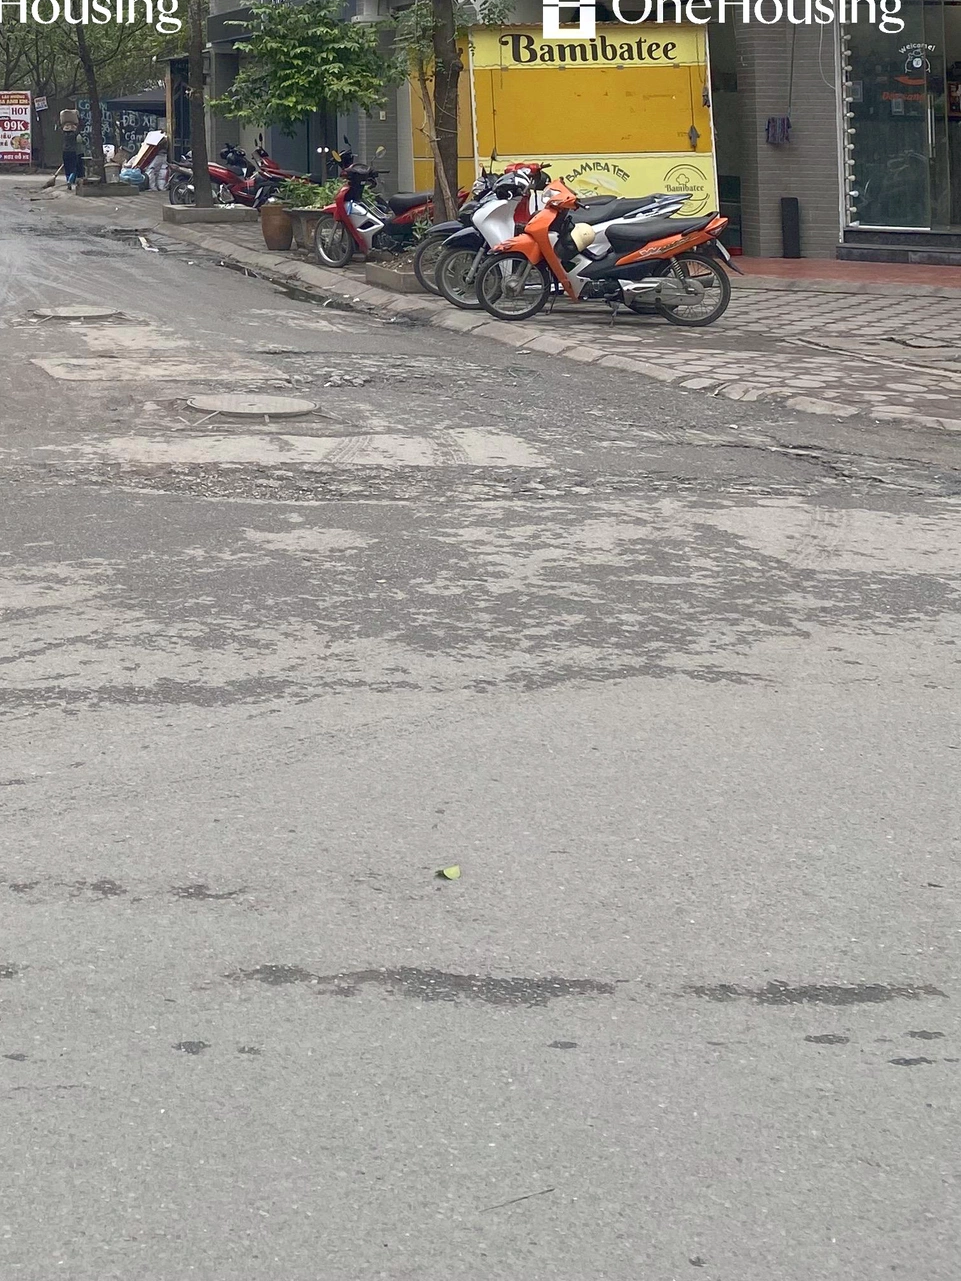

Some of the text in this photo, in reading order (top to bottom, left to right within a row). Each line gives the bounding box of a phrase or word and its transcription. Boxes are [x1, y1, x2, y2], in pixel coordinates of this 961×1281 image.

[499, 33, 678, 64] Bamibatee
[11, 107, 28, 115] HOT
[3, 121, 26, 131] 99K
[665, 183, 704, 193] Bamibatee
